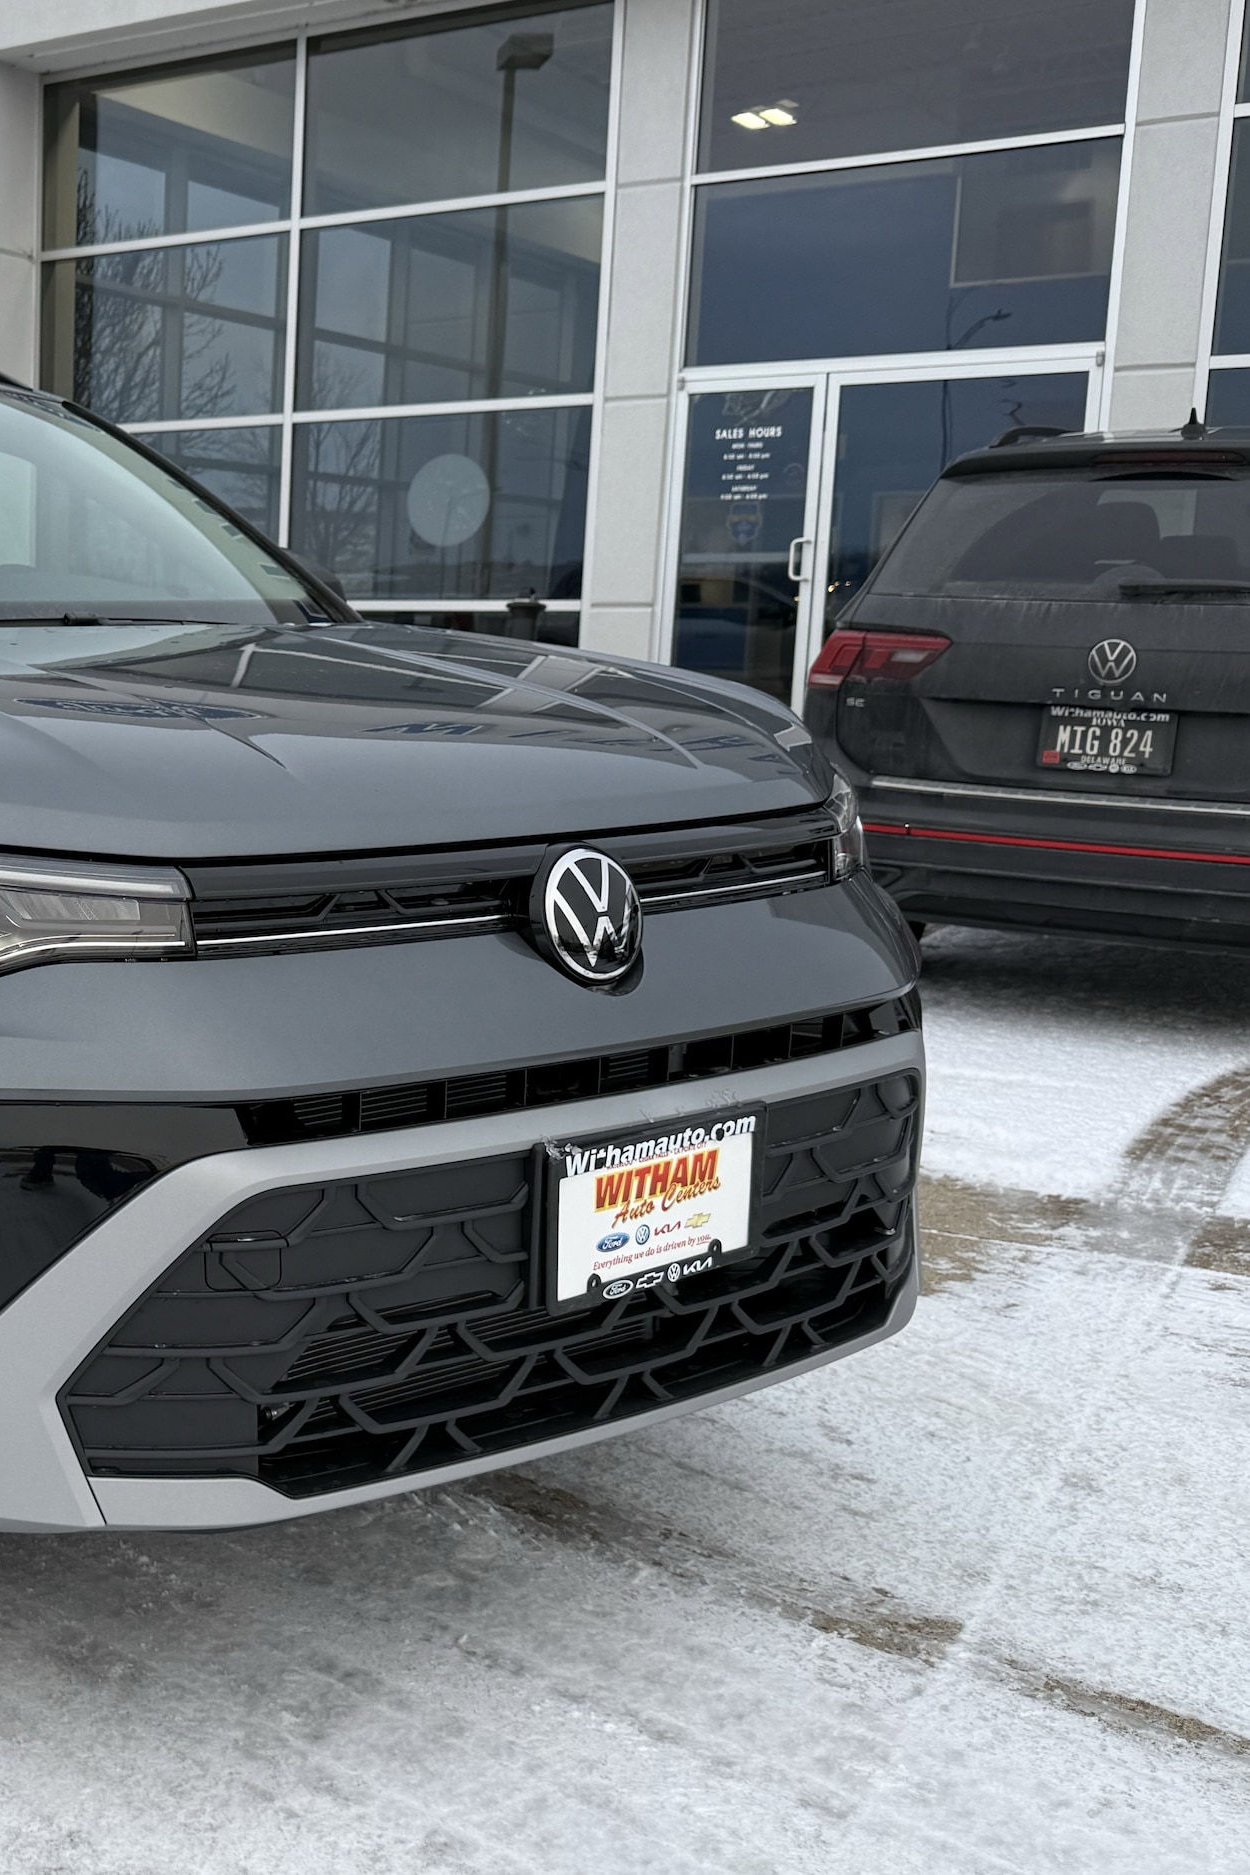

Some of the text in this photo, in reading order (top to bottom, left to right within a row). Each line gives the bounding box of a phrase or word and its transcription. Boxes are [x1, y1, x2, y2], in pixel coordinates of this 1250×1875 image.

[715, 426, 782, 440] SALES HOURS
[1052, 688, 1167, 703] TIGUAN
[1055, 725, 1153, 759] MIG 824
[594, 1147, 720, 1213] WITHAM
[611, 1175, 721, 1229] Auto Centers
[593, 1254, 633, 1271] Everything
[634, 1251, 644, 1260] we
[645, 1247, 655, 1257] do
[656, 1245, 662, 1254] is
[663, 1239, 686, 1252] driven
[688, 1236, 696, 1247] by
